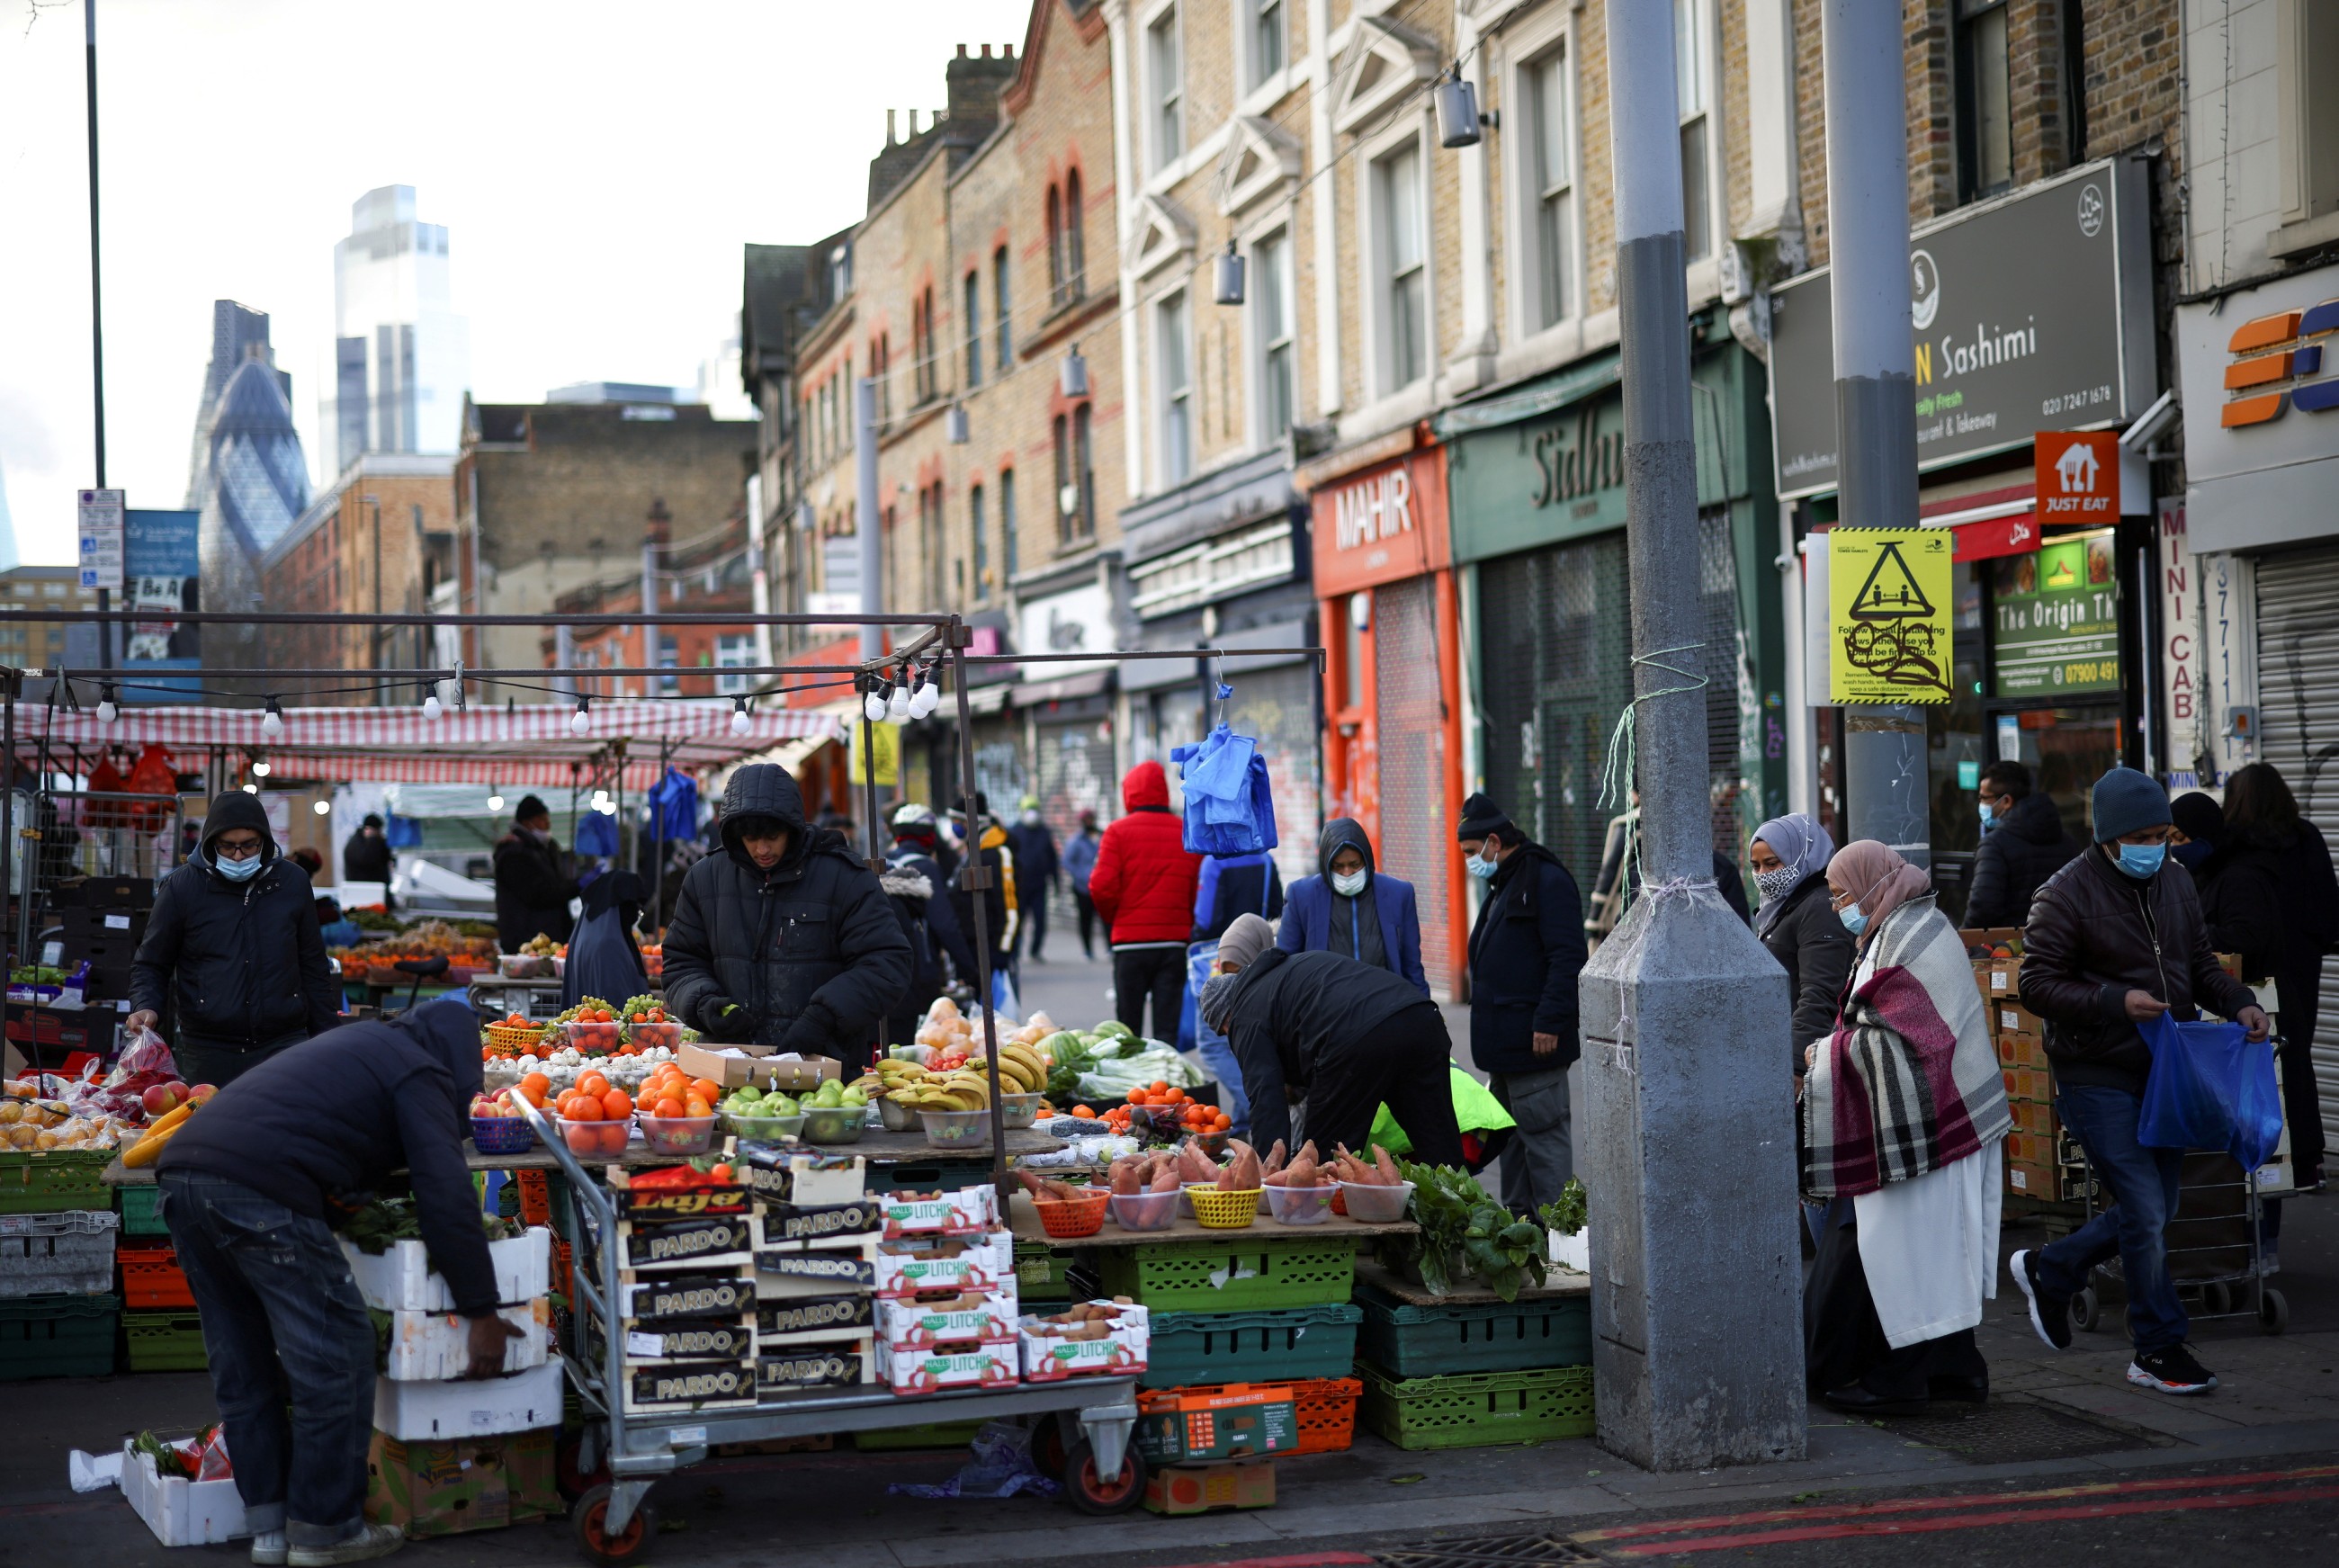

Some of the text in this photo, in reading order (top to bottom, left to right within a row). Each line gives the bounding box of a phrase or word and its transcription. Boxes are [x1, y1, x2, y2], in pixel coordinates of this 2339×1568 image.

[1940, 315, 2036, 379] Sashimi
[2042, 399, 2061, 416] 020
[2063, 390, 2086, 411] 7247
[1956, 410, 1997, 434] Takeaway
[1334, 467, 1411, 551] MAHIR
[2046, 497, 2110, 513] JUST EAT
[2163, 508, 2187, 622] MINI
[142, 577, 163, 597] Be
[1998, 604, 2026, 631] The
[2033, 597, 2085, 631] Origin
[1869, 625, 1896, 634] ocial
[1899, 625, 1945, 636] dstaning
[1919, 637, 1934, 647] yo
[1875, 647, 1887, 656] be
[1928, 648, 1937, 656] to
[2065, 662, 2097, 684] 07900
[2169, 633, 2192, 719] CAB
[786, 1206, 879, 1239] PARDO Gold
[915, 1203, 954, 1219] LITCHIS
[651, 1224, 748, 1259] PARDO Gold
[780, 1259, 873, 1283] PARDO Gold
[931, 1260, 970, 1277] LITCHIS
[656, 1284, 753, 1315] PARDO Gold
[777, 1299, 871, 1331] PARDO Gold
[950, 1312, 990, 1329] LITCHIS
[730, 1332, 748, 1357] Gold
[1080, 1340, 1119, 1357] LITCHIS
[767, 1357, 860, 1383] PARDO Gold
[953, 1355, 991, 1372] LITCHIS
[658, 1372, 754, 1401] PARDO Gold
